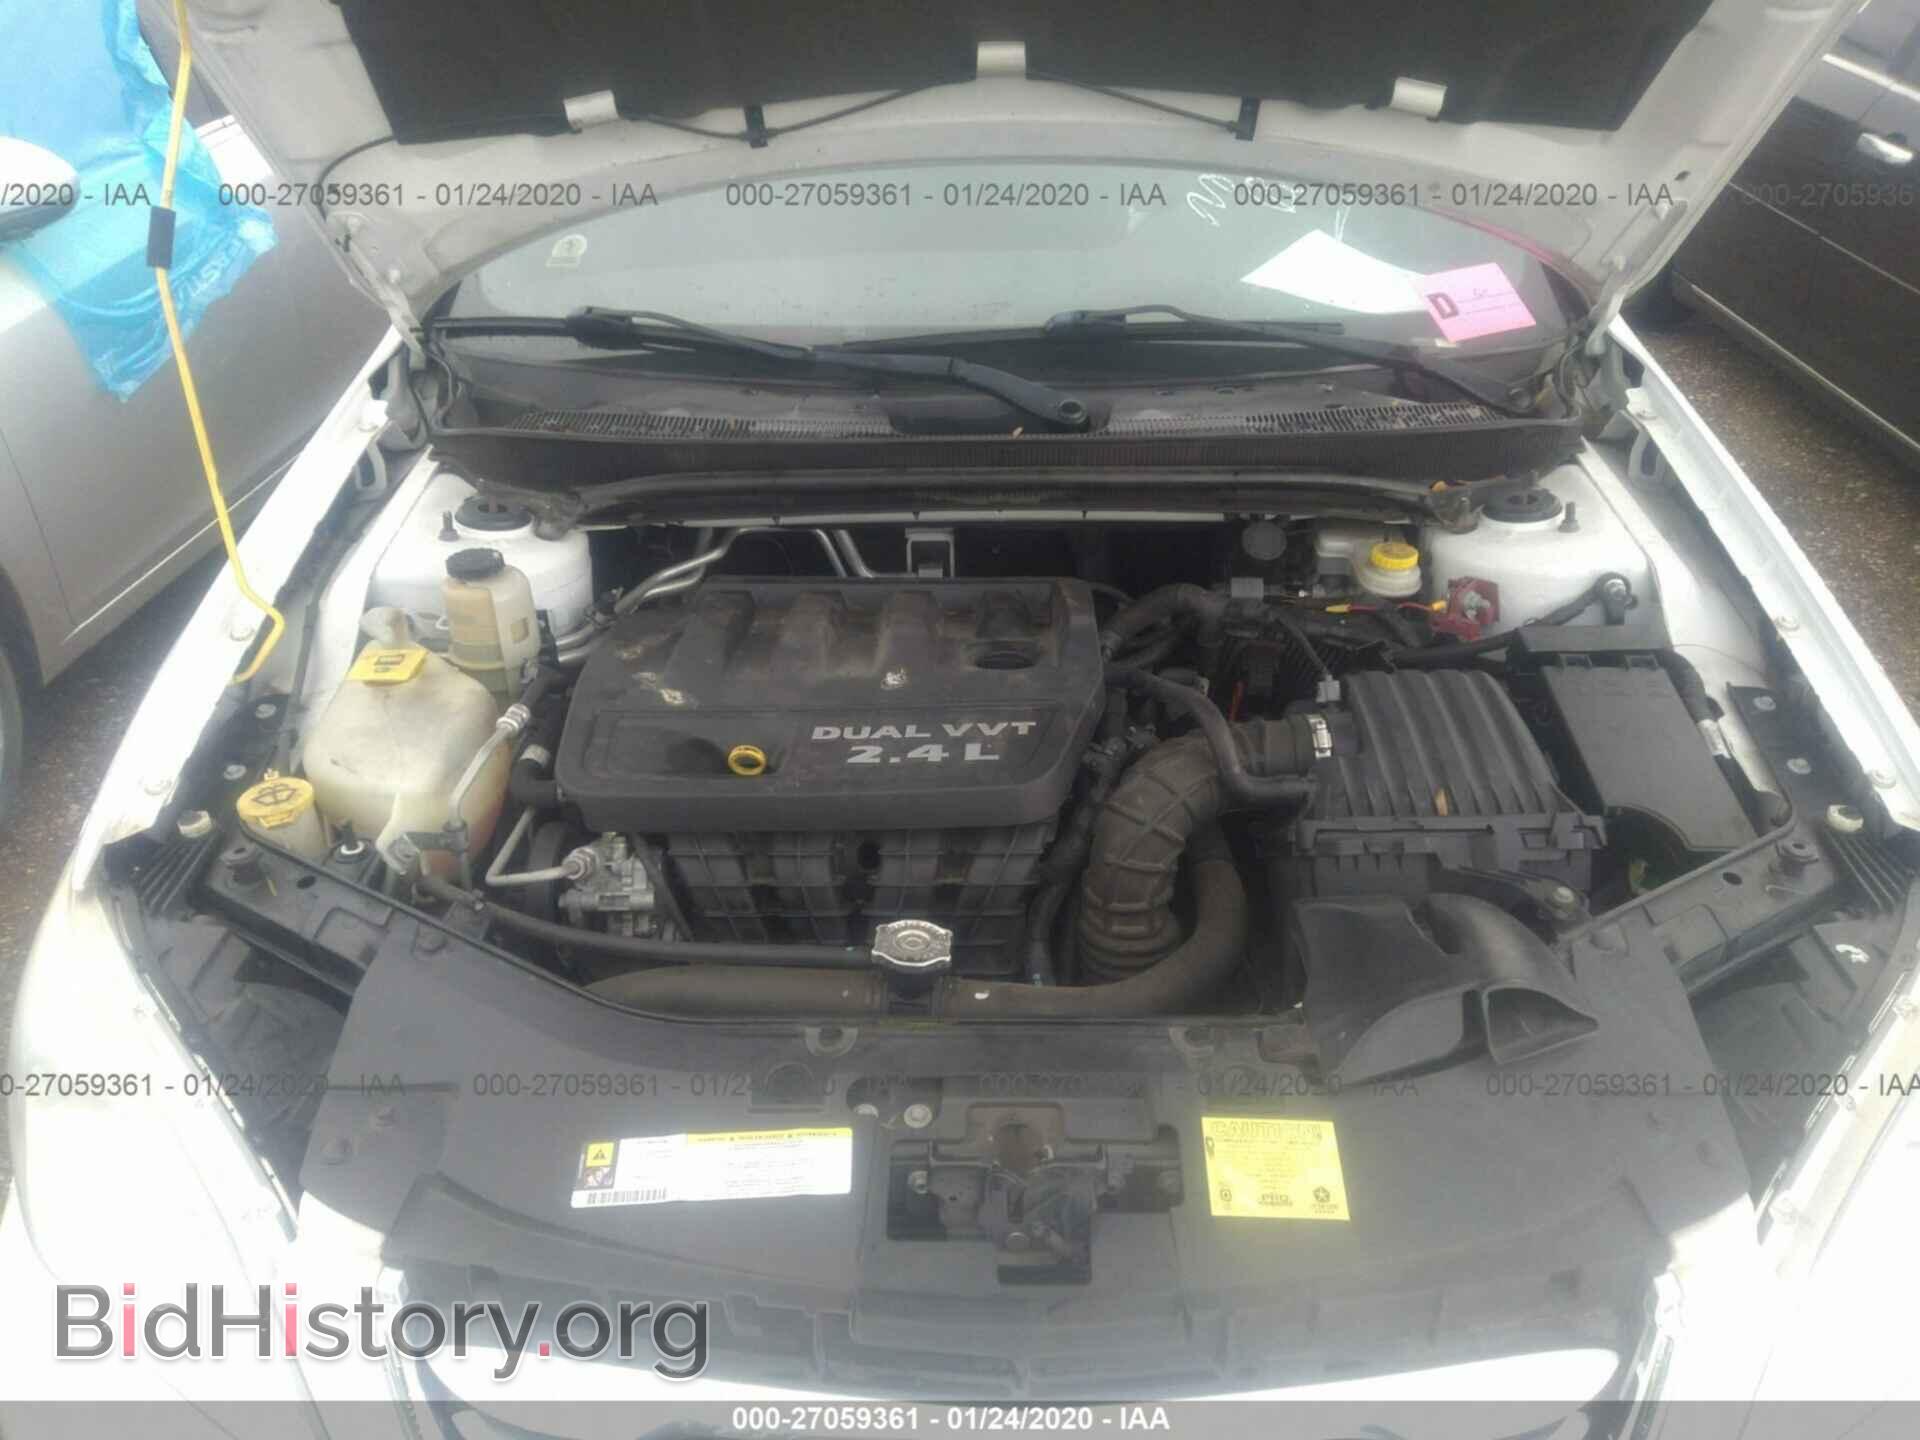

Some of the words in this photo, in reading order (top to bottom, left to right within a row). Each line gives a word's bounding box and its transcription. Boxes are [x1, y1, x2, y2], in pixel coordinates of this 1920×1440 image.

[1426, 293, 1459, 320] D
[811, 724, 932, 740] DUAL
[942, 721, 1037, 737] VVT
